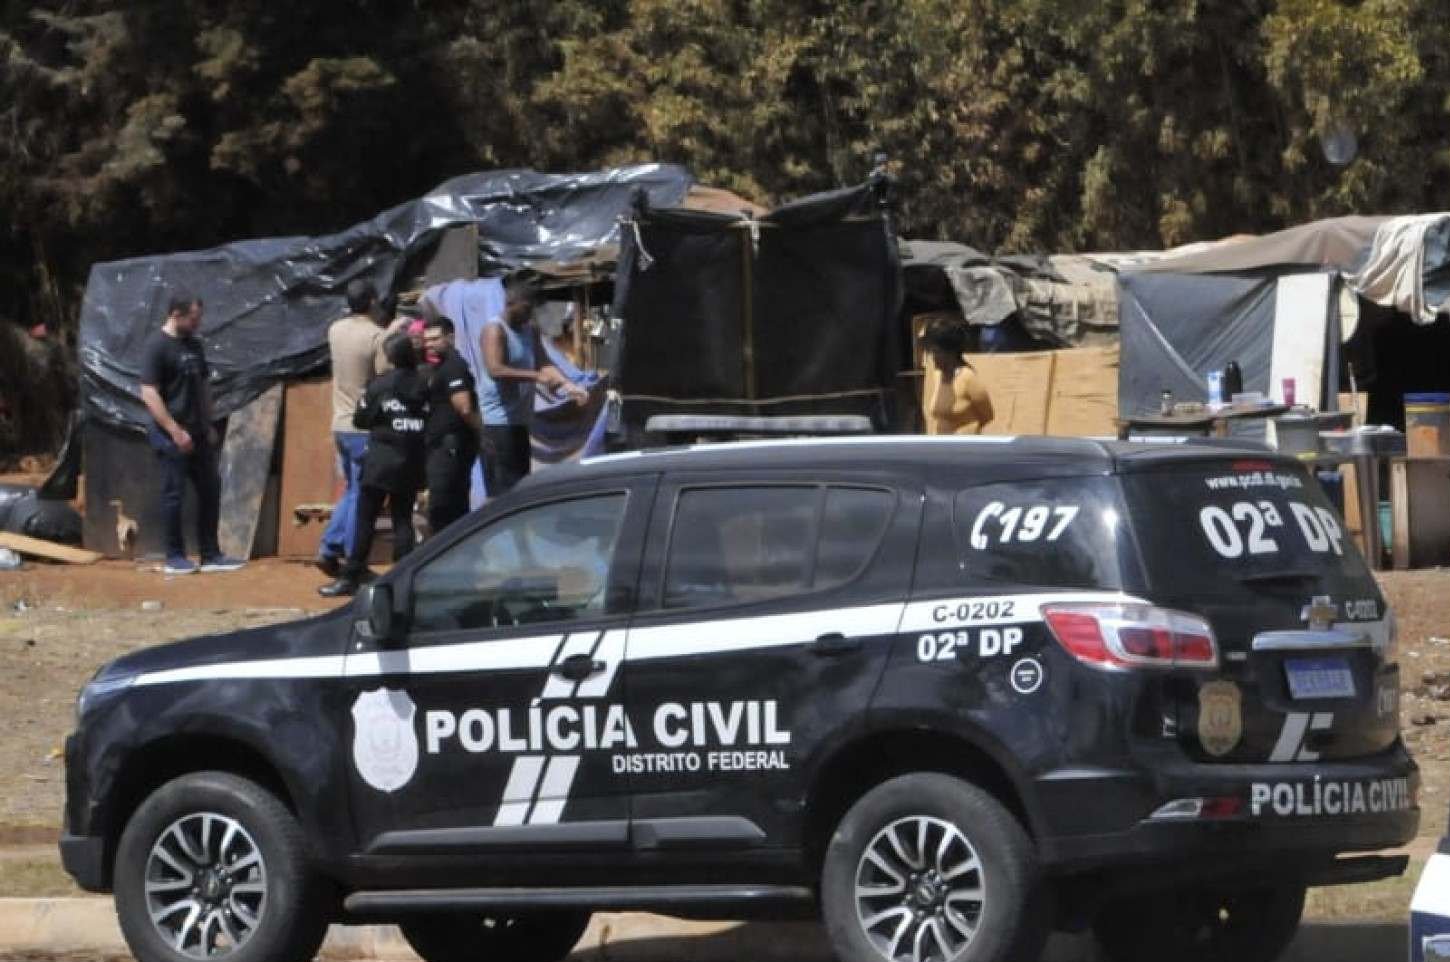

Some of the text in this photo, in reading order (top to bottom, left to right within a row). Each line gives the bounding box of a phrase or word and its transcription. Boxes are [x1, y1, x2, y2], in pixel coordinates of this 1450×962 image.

[1000, 506, 1080, 542] 197
[1289, 502, 1343, 555] DP
[932, 601, 1015, 622] C-0202
[979, 628, 1023, 656] DP
[426, 698, 791, 753] POLÍCIA CIVIL
[612, 751, 790, 773] DISTRITO FEDERAL
[1251, 774, 1409, 815] POLÍCIA CIVIL
